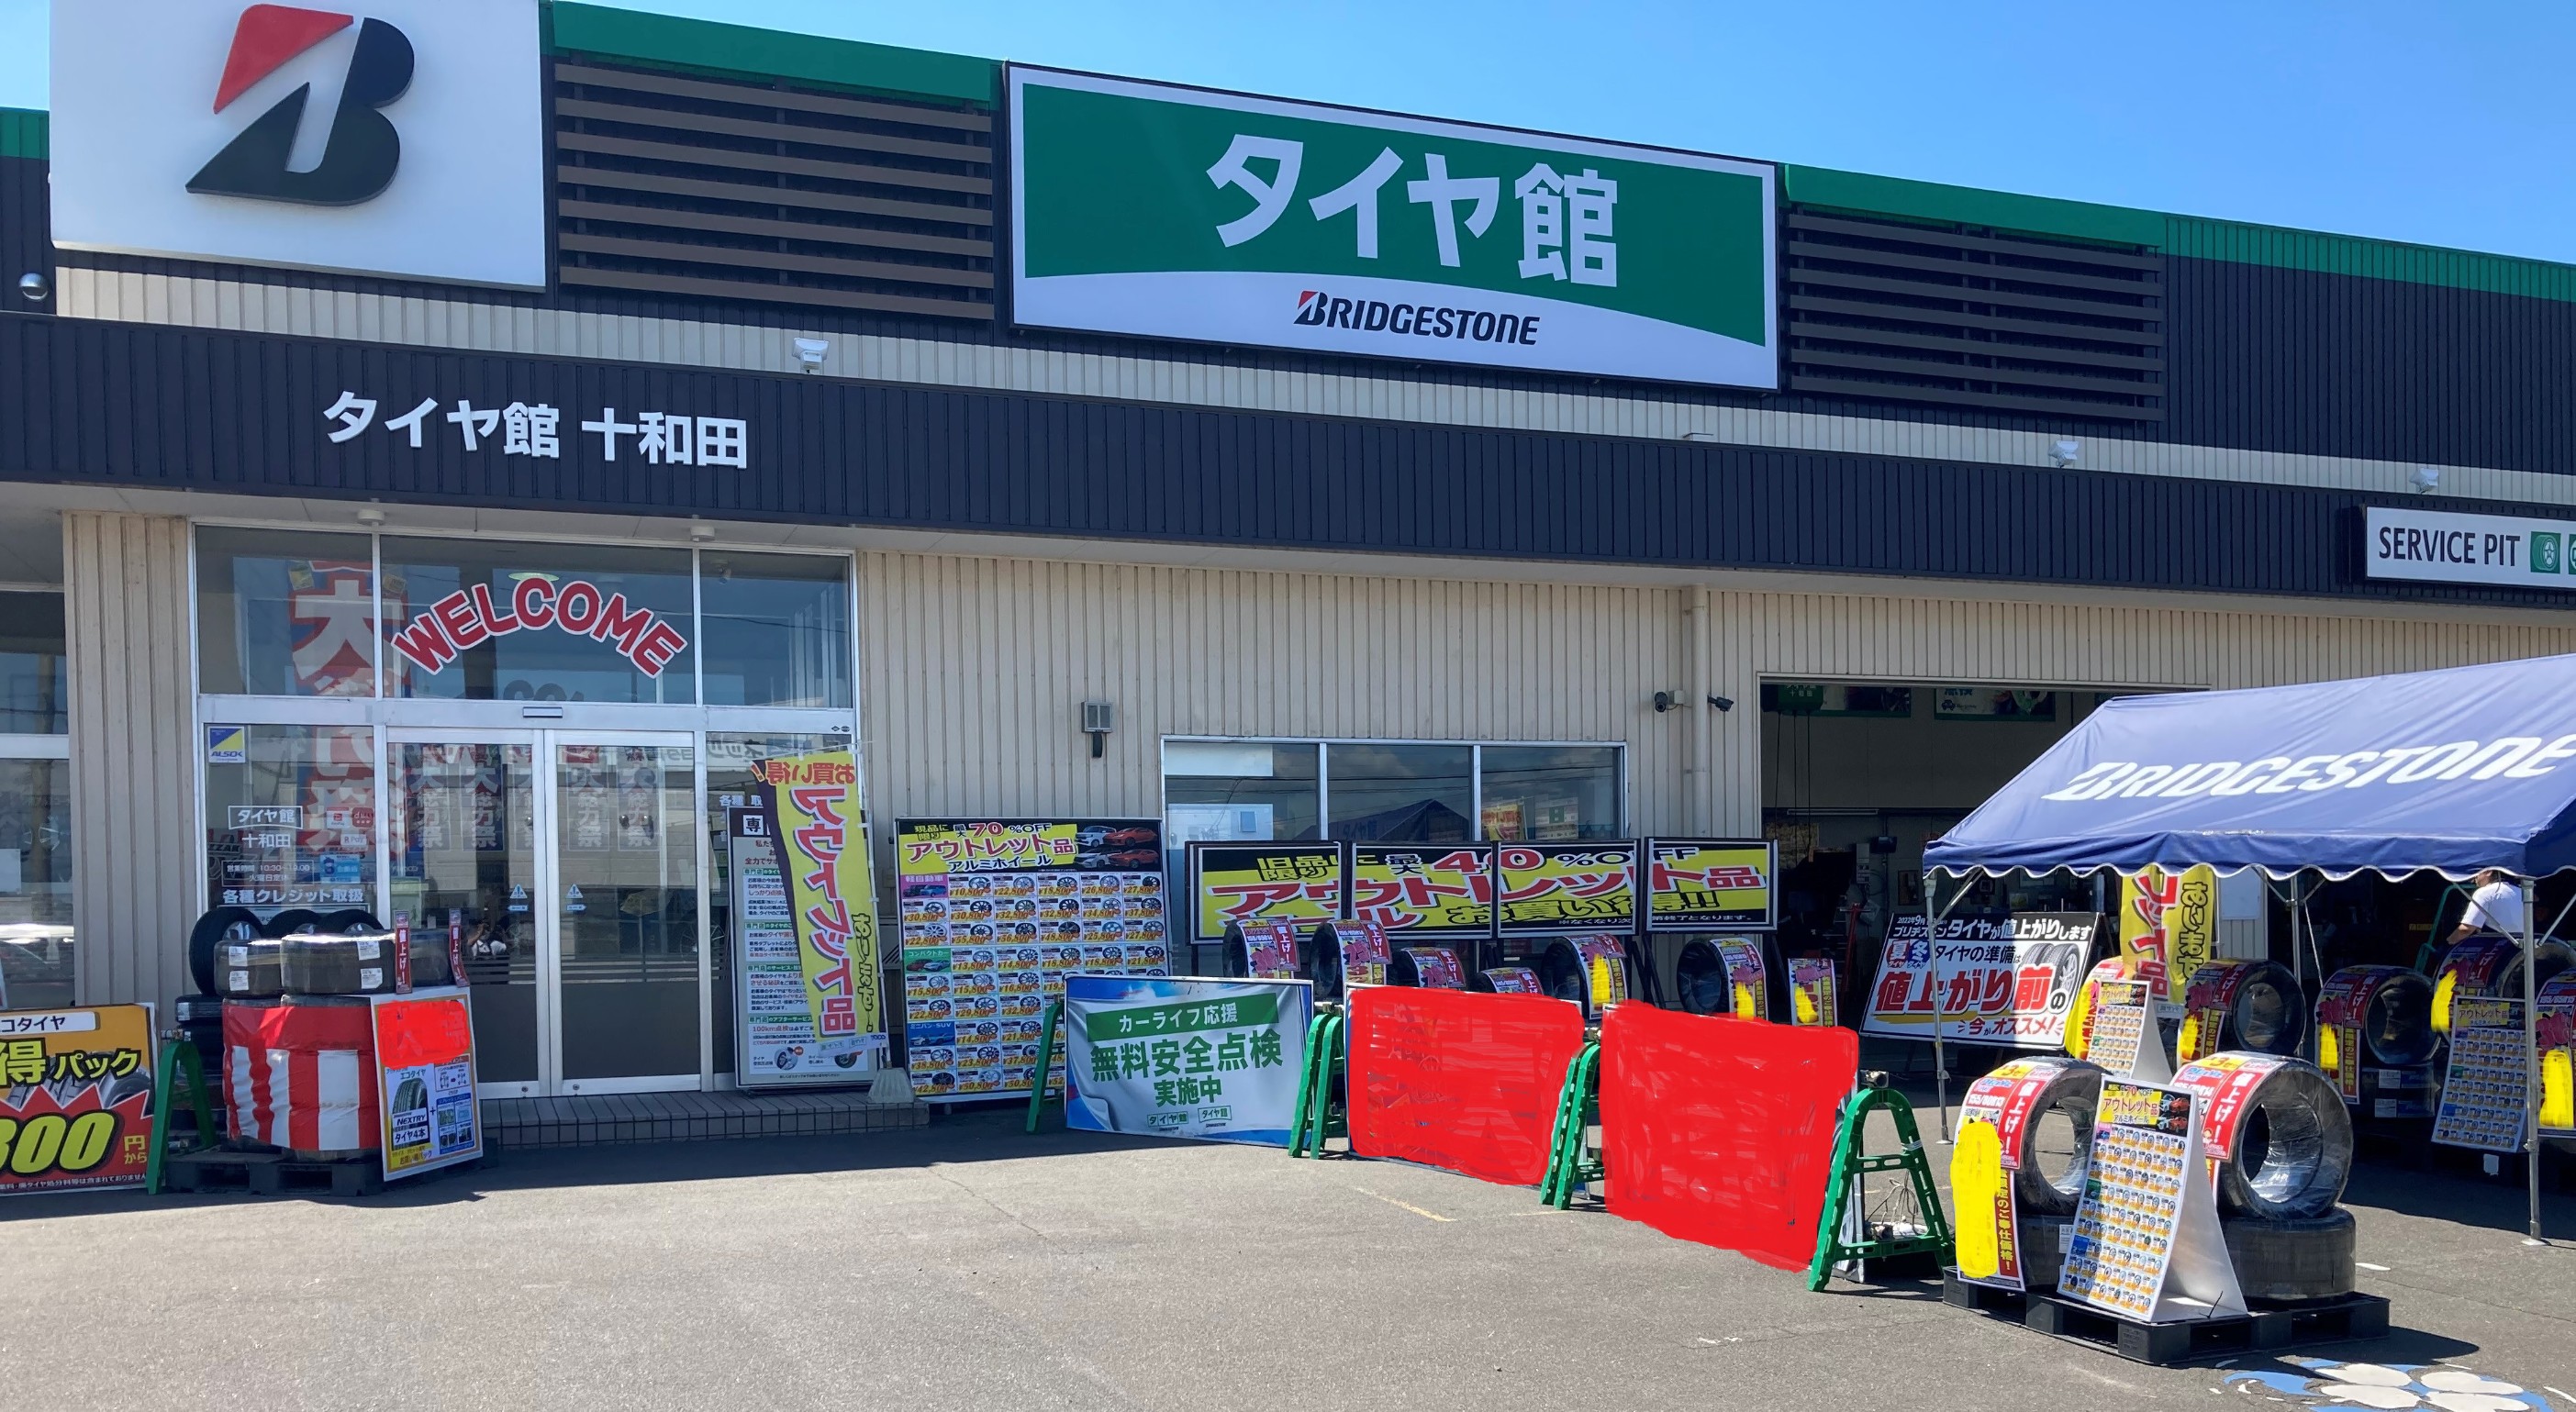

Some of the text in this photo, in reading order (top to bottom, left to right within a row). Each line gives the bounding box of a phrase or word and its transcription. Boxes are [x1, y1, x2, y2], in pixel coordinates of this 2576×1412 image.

[1207, 134, 1618, 287] タイヤ館
[1295, 290, 1539, 346] BRIDGESTONE
[324, 390, 748, 469] タイヤ館 十和田
[2380, 527, 2520, 567] SERVICE PIT
[391, 578, 686, 679] WELCOME
[2042, 734, 2576, 801] BRIDGESTONE
[751, 795, 763, 806] 取
[238, 809, 295, 824] タイヤ館
[242, 833, 290, 848] 十和田
[968, 822, 1004, 837] 70
[1009, 823, 1053, 834] %OFF
[907, 834, 1076, 862] アウトレット品
[948, 855, 1054, 873] アルミホイール
[1206, 865, 1767, 916] アウトレット品
[0, 1016, 66, 1033] コタイヤ
[1119, 1002, 1237, 1033] カーライフ応援
[2459, 1008, 2509, 1020] アウトレット品
[1090, 1028, 1284, 1083] 無料安全点検
[1154, 1074, 1222, 1107] 実施中
[2102, 1097, 2158, 1117] アウトレット品
[396, 1115, 426, 1126] NEXTRY
[124, 1135, 146, 1151] 円
[395, 1127, 428, 1144] タイヤ4本
